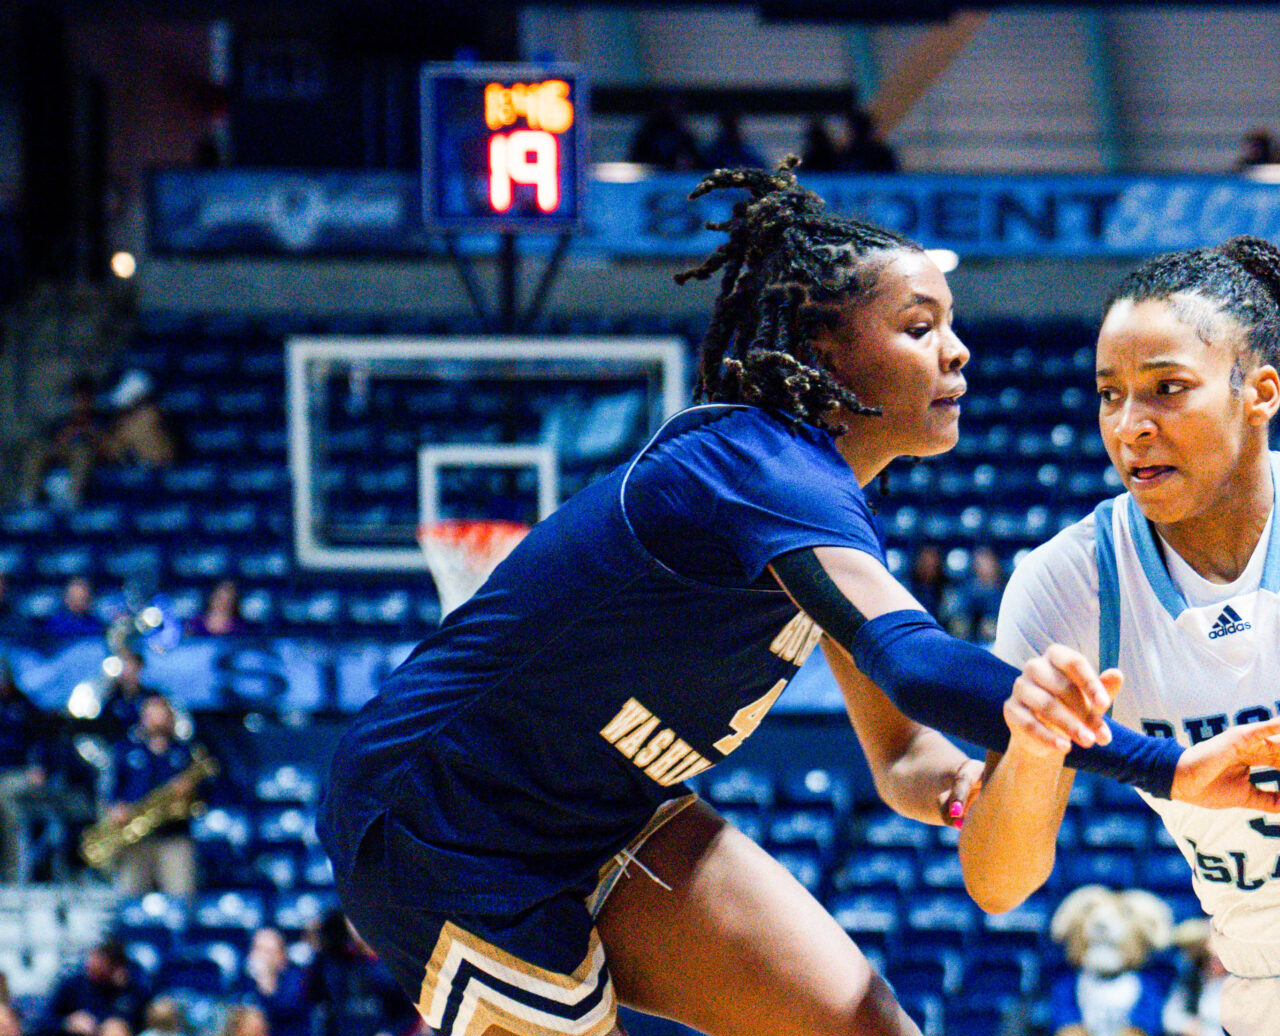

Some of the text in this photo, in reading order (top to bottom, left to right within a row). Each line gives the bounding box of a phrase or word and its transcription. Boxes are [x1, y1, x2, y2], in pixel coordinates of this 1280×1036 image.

[489, 129, 560, 213] 19
[643, 190, 1117, 241] SDENT
[1208, 622, 1252, 640] adidas
